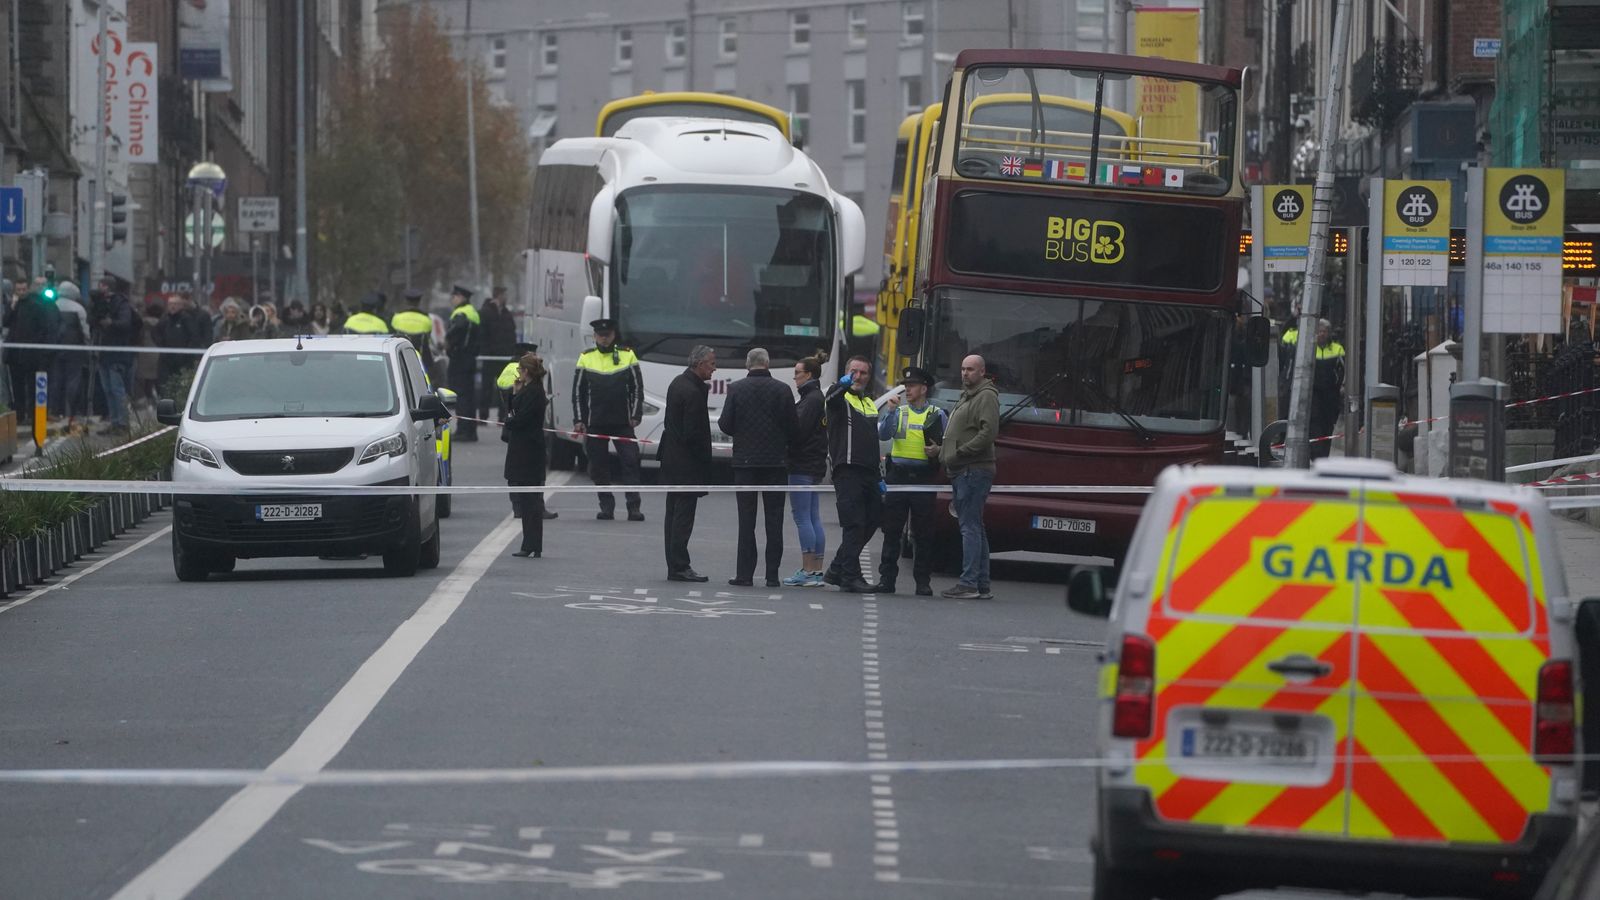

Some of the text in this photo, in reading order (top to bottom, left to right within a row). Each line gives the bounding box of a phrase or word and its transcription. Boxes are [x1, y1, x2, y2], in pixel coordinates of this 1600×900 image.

[129, 82, 149, 157] Chime
[242, 210, 275, 219] RAMPS
[1515, 211, 1533, 219] BUS
[1047, 216, 1091, 241] BIG
[1045, 239, 1089, 262] BUS
[263, 506, 319, 517] 222-D-21282
[1042, 518, 1091, 531] 00-D-70136
[1262, 543, 1454, 589] GARDA
